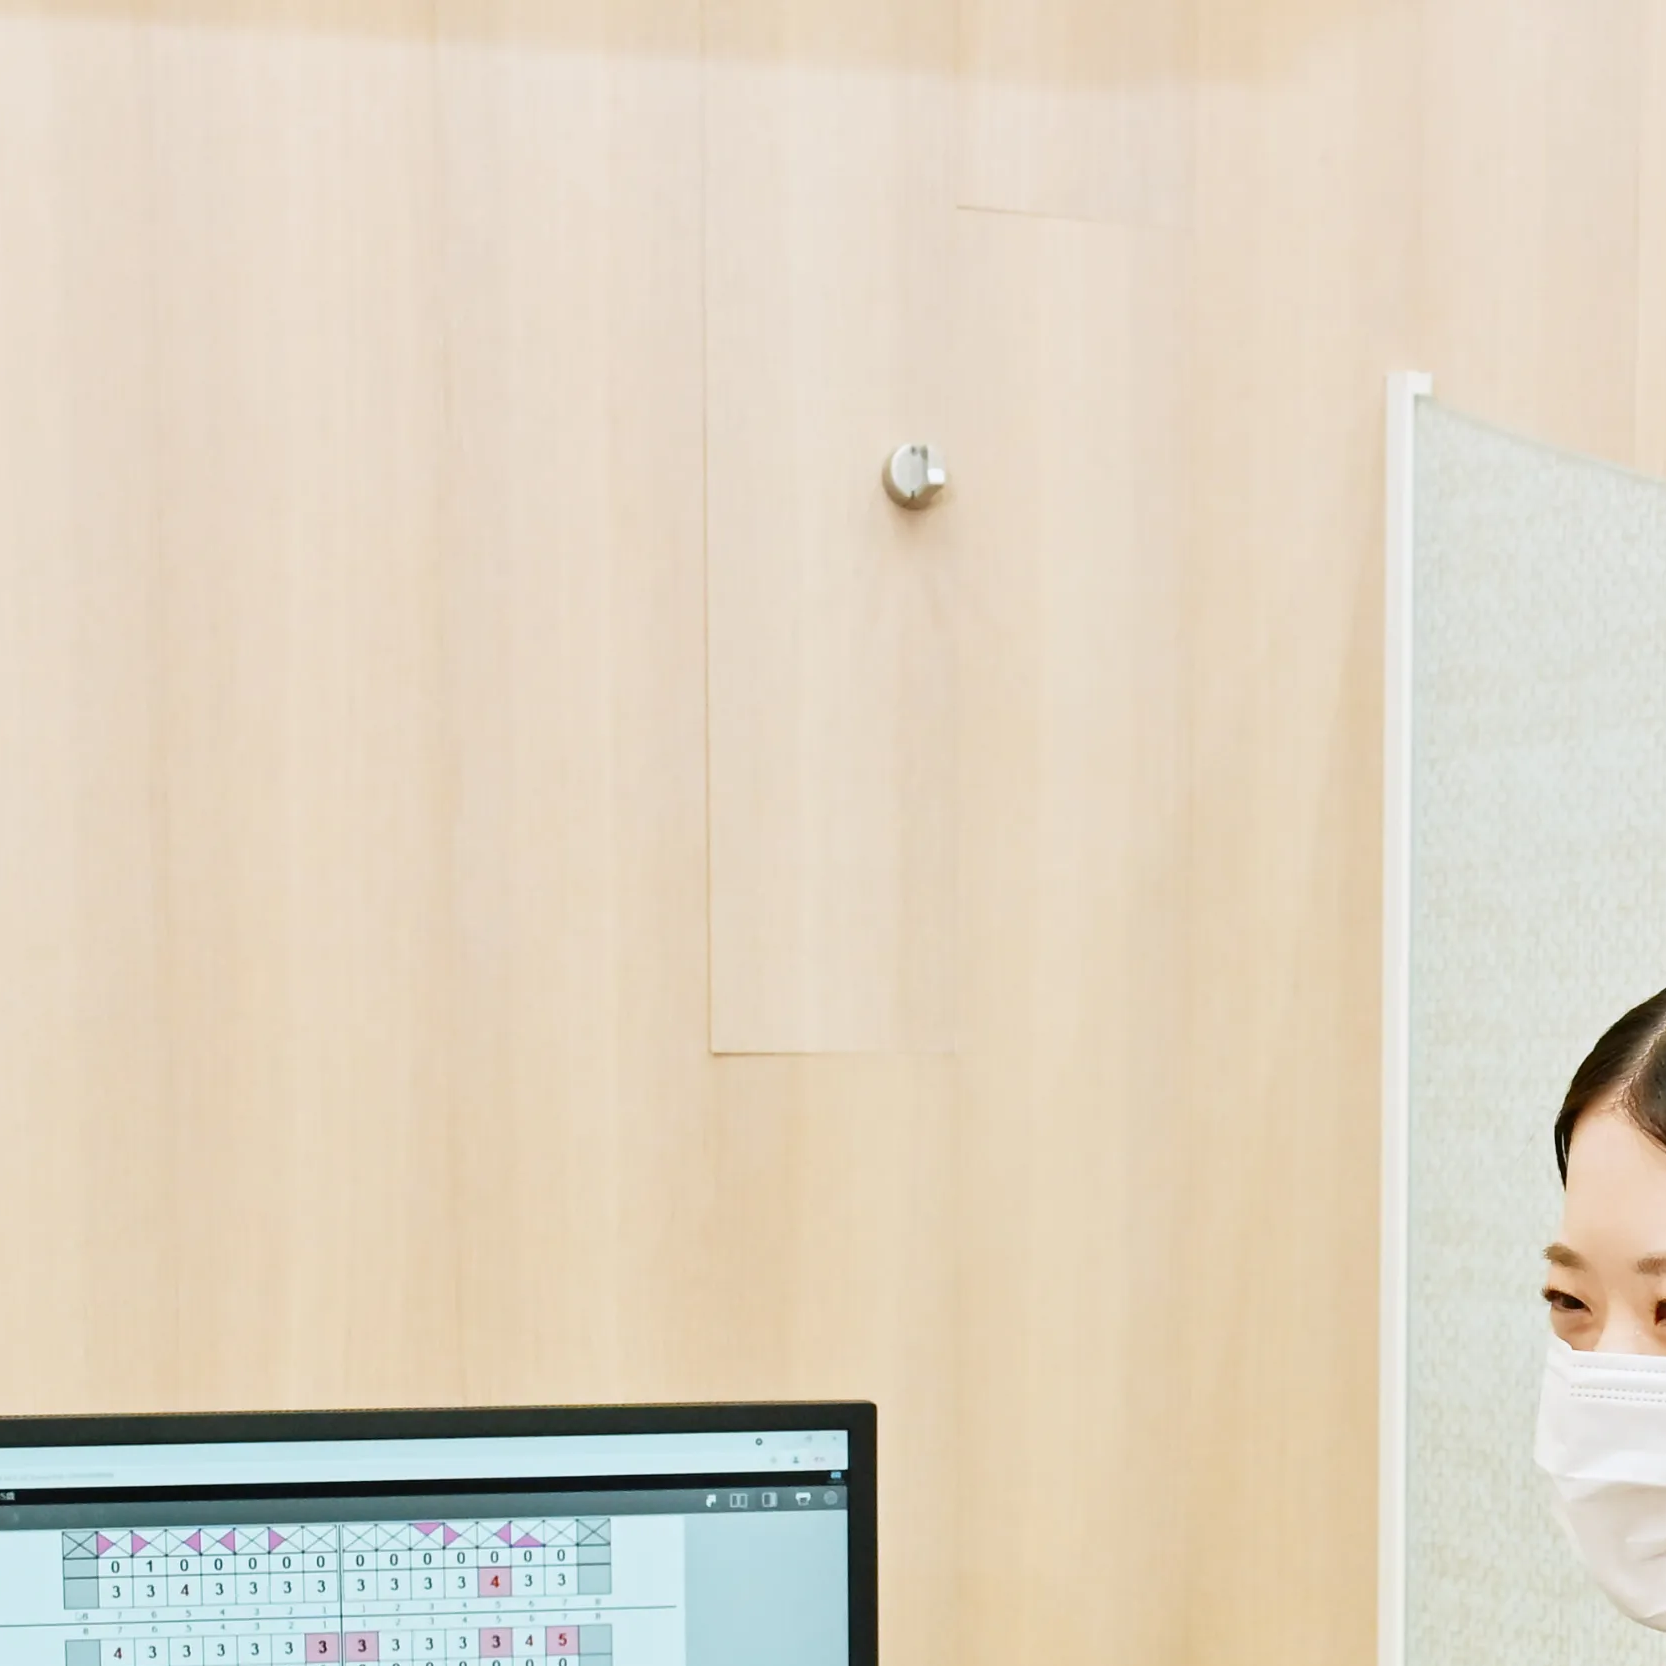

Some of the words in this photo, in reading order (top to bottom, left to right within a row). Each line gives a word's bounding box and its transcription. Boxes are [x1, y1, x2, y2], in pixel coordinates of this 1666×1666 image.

[110, 1560, 121, 1574] 0
[179, 1558, 189, 1572] 0
[213, 1557, 223, 1571] 0
[248, 1557, 258, 1570] 0
[282, 1556, 292, 1569] 0
[316, 1555, 326, 1569] 0
[355, 1554, 365, 1567] 0
[389, 1553, 399, 1567] 0
[423, 1552, 432, 1566] 0
[456, 1551, 466, 1565] 0
[490, 1550, 499, 1564] 0
[523, 1550, 533, 1563] 0
[556, 1548, 566, 1562] 0
[112, 1585, 121, 1599] 3
[146, 1584, 156, 1598] 3
[180, 1583, 190, 1597] 4
[215, 1582, 224, 1596] 3
[249, 1581, 258, 1595] 3
[283, 1580, 292, 1594] 3
[317, 1579, 326, 1593] 3
[357, 1578, 366, 1592] 3
[390, 1577, 399, 1591] 3
[424, 1576, 433, 1590] 3
[457, 1575, 466, 1590] 3
[490, 1575, 500, 1588] 4
[524, 1574, 533, 1588] 3
[557, 1572, 567, 1587] 3
[113, 1647, 123, 1660] 4
[148, 1645, 158, 1659] 3
[183, 1644, 192, 1658] 3
[217, 1643, 226, 1657] 3
[251, 1642, 260, 1656] 3
[284, 1641, 294, 1655] 3
[318, 1640, 328, 1654] 3
[357, 1638, 367, 1653] 3
[392, 1638, 401, 1652] 3
[425, 1637, 434, 1651] 3
[459, 1636, 468, 1650] 3
[492, 1634, 501, 1649] 3
[524, 1634, 534, 1647] 4
[558, 1632, 568, 1647] 5
